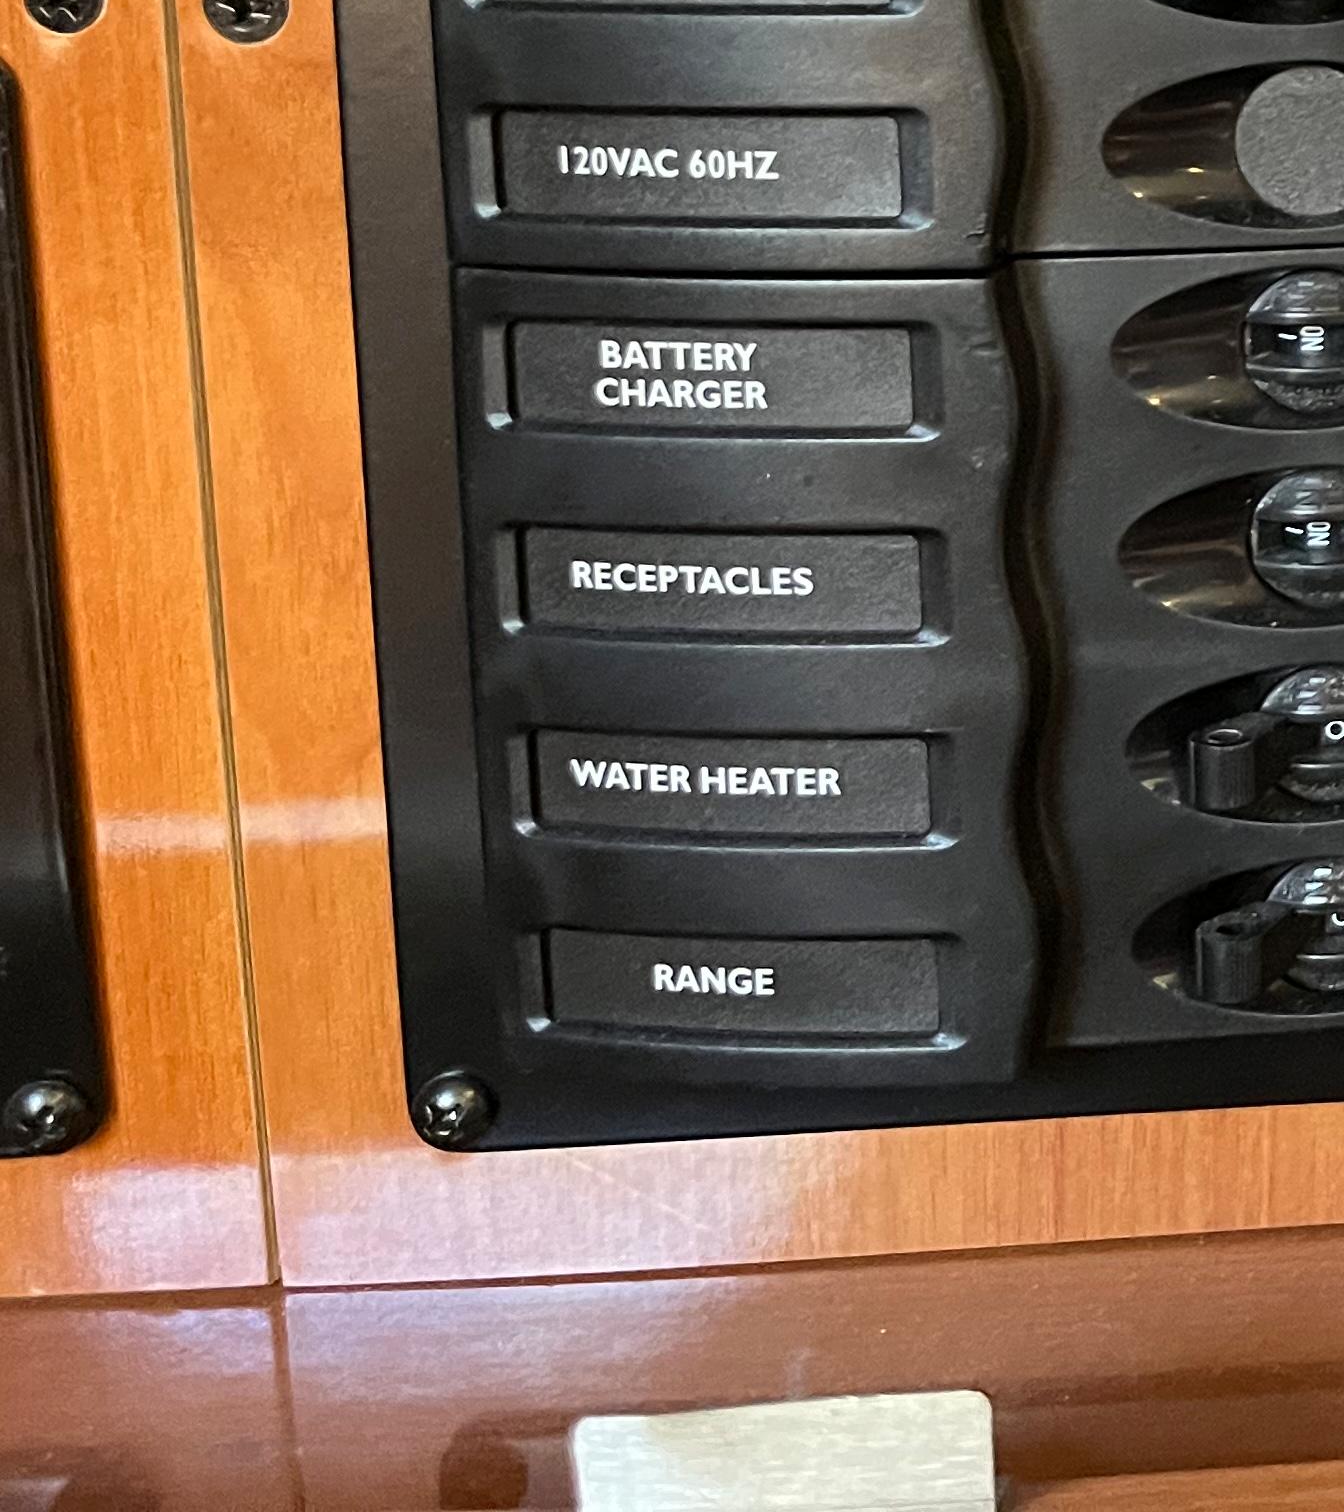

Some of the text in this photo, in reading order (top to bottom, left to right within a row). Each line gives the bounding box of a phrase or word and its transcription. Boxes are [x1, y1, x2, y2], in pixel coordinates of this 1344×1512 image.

[558, 145, 780, 180] 120VAC 60HZ
[599, 339, 758, 372] BATTERY
[594, 377, 768, 410] CHARGER
[571, 560, 814, 596] RECEPTACLES
[569, 758, 842, 796] WATER HEATER
[653, 963, 775, 996] RANGE
